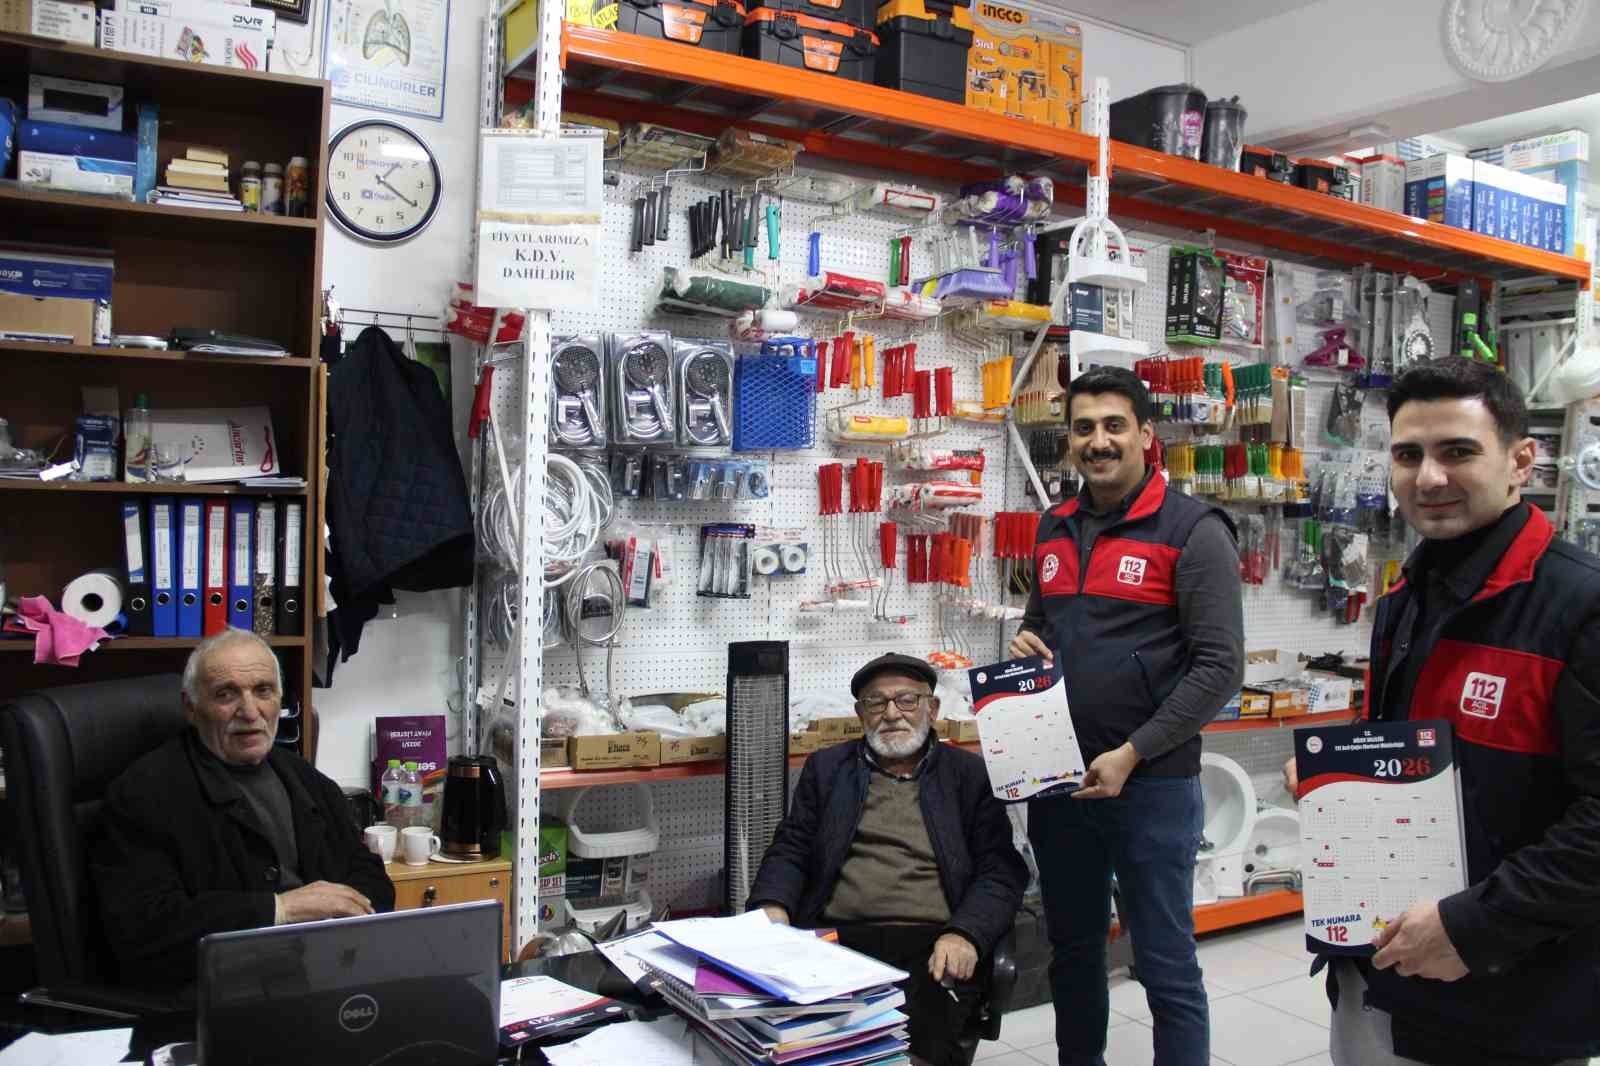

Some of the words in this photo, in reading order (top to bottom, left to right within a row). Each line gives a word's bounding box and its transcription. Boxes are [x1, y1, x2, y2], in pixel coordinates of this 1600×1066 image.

[1123, 560, 1142, 574] 112
[1018, 674, 1053, 692] 2026
[1471, 678, 1498, 700] 112
[1373, 757, 1432, 777] 2026
[1005, 787, 1020, 799] 112
[1311, 917, 1326, 928] TEK
[1326, 913, 1362, 926] NUMARA
[1325, 925, 1349, 942] 112
[343, 1006, 376, 1020] DELL
